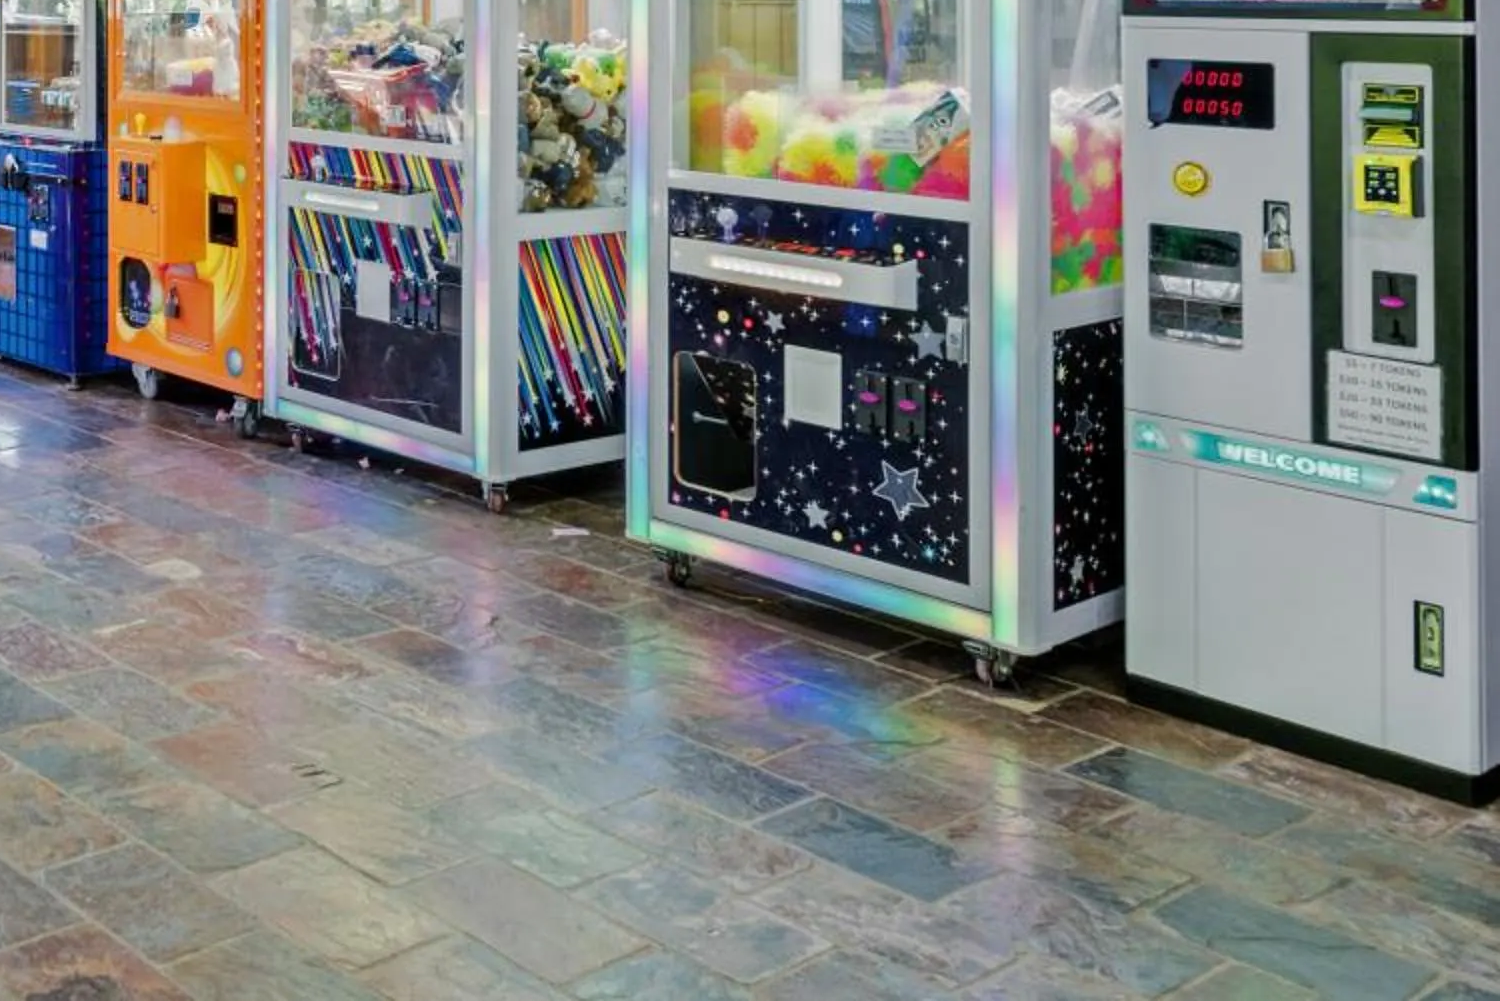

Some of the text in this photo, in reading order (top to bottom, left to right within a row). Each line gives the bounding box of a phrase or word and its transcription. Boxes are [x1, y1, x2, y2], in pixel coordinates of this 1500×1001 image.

[1182, 70, 1243, 87] 00000
[1183, 99, 1243, 117] 00050
[1380, 363, 1421, 378] TOKENS
[1386, 381, 1428, 396] TOKENS
[1386, 398, 1428, 413] TOKENS
[1386, 415, 1428, 432] TOKENS
[1217, 442, 1360, 484] WELCOME
